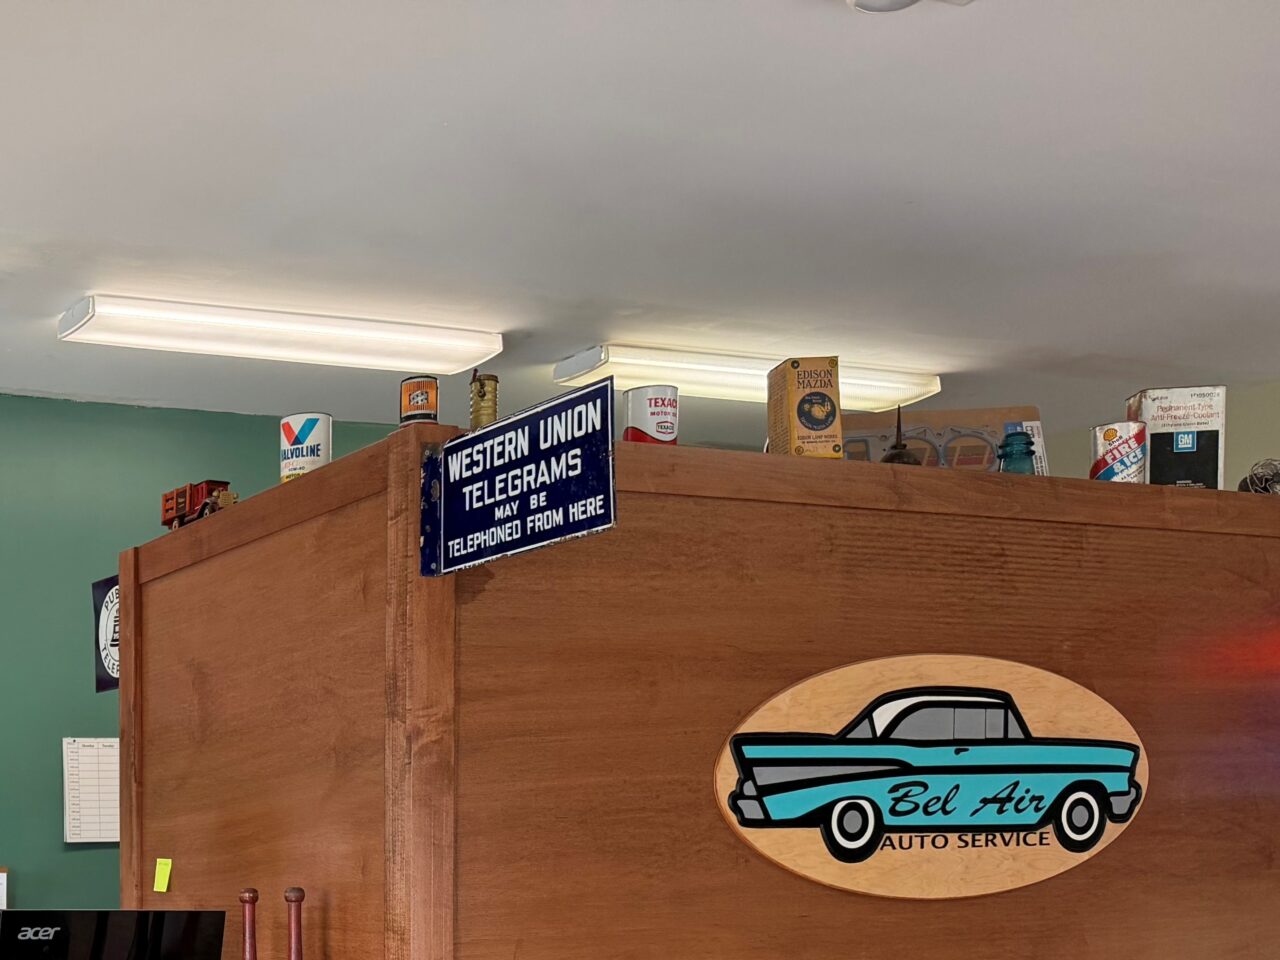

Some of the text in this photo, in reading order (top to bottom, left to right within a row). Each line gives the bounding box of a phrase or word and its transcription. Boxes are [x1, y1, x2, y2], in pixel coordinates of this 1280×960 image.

[797, 369, 833, 380] EDISON
[797, 379, 833, 389] MAZDA
[448, 399, 602, 482] WESTERN UNION
[1104, 438, 1138, 464] FIRE
[1178, 434, 1192, 445] GM
[1113, 462, 1126, 473] &
[1123, 448, 1144, 467] ICE
[463, 448, 582, 511] TELEGRAMS
[495, 492, 547, 521] MAY BE
[448, 494, 604, 558] TELEPHONED FROM HERE
[888, 779, 1047, 818] Bel Air
[880, 831, 1051, 851] AUTO SERVICE
[18, 926, 61, 940] acer
